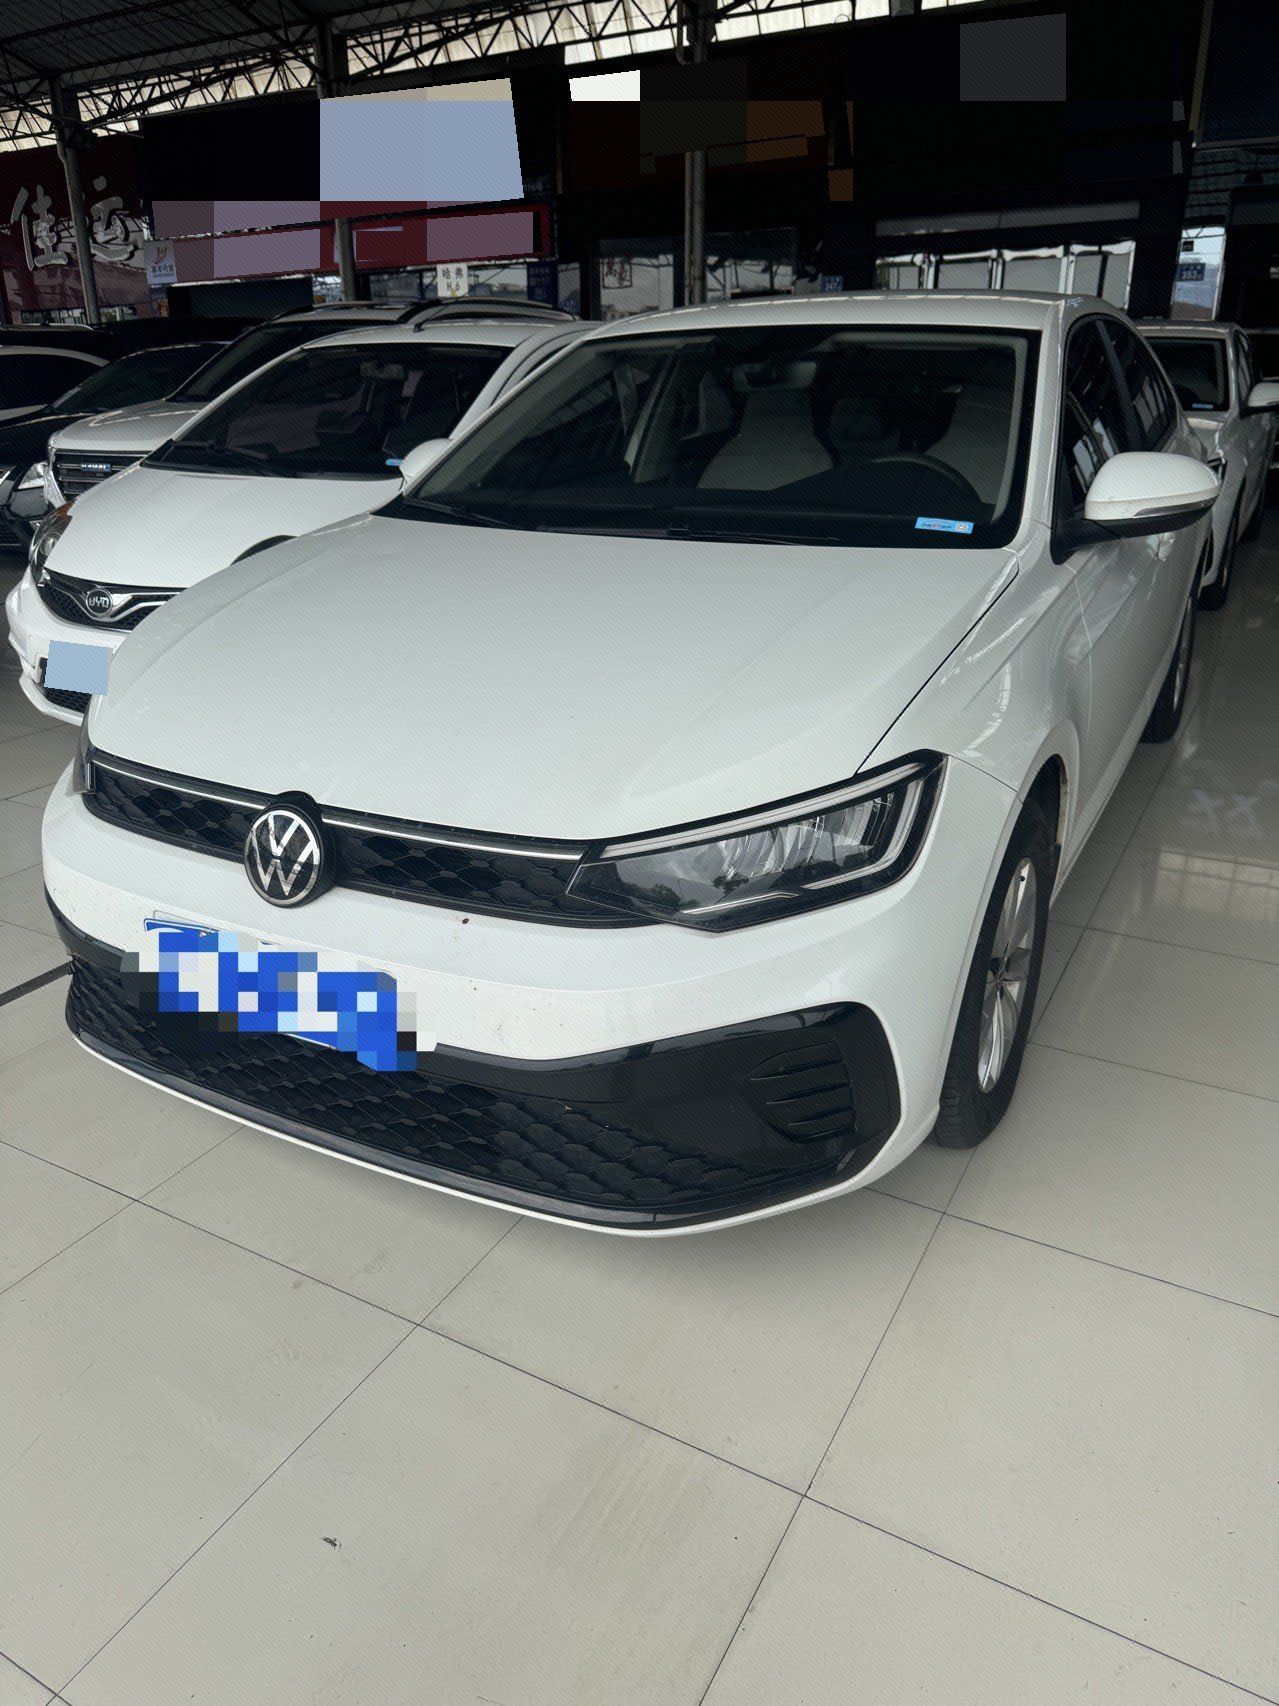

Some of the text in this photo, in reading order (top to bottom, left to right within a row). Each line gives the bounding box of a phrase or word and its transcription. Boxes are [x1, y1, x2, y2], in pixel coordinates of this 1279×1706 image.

[441, 266, 464, 279] 哈弗
[88, 595, 109, 609] BYD
[250, 812, 316, 898] VW
